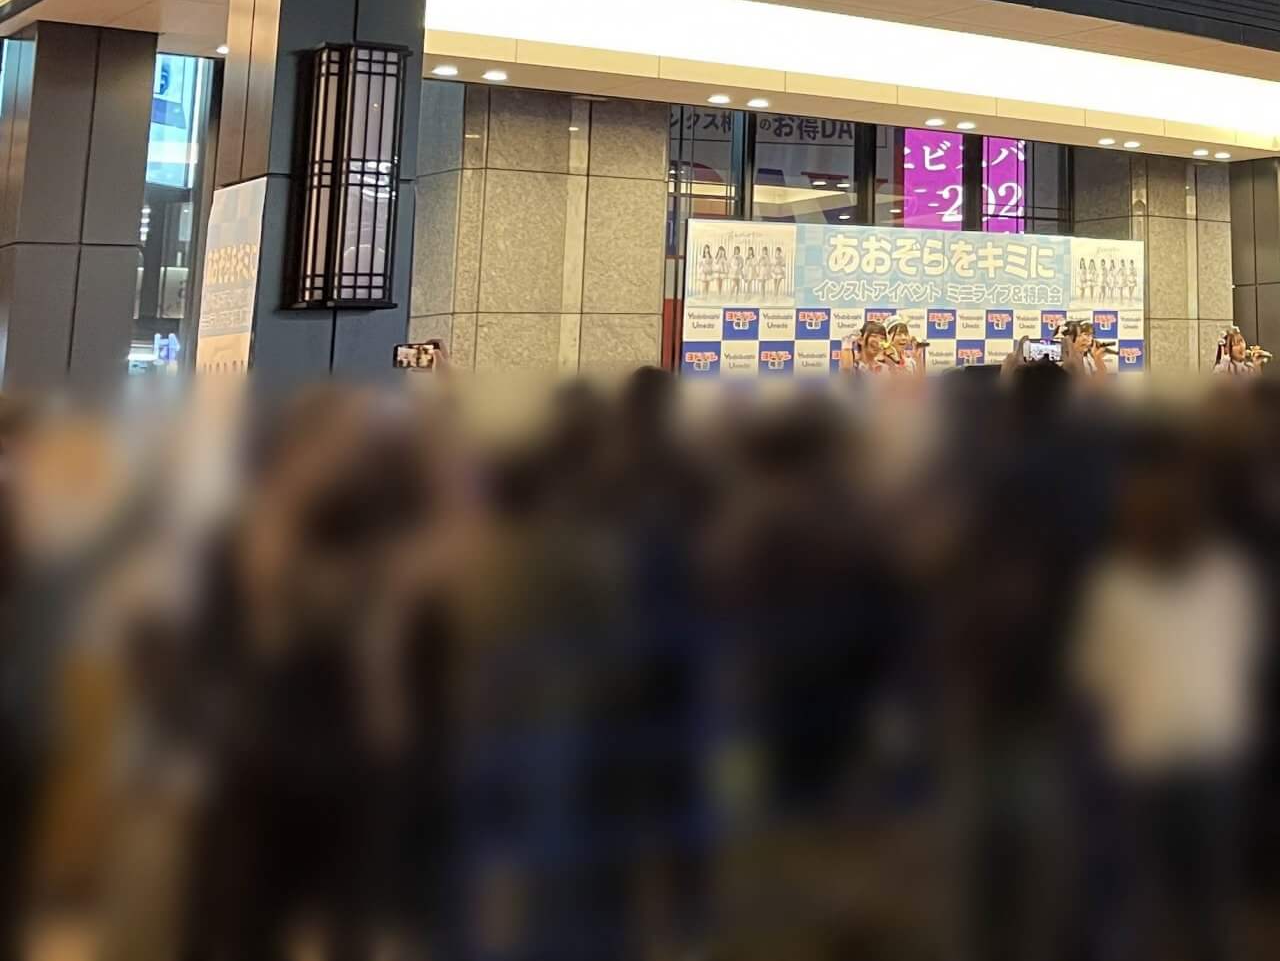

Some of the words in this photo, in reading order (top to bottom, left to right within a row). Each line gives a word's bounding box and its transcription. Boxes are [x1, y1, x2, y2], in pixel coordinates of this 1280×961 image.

[828, 234, 1057, 279] あおぞらをキミに
[814, 279, 941, 304] インストアイベント
